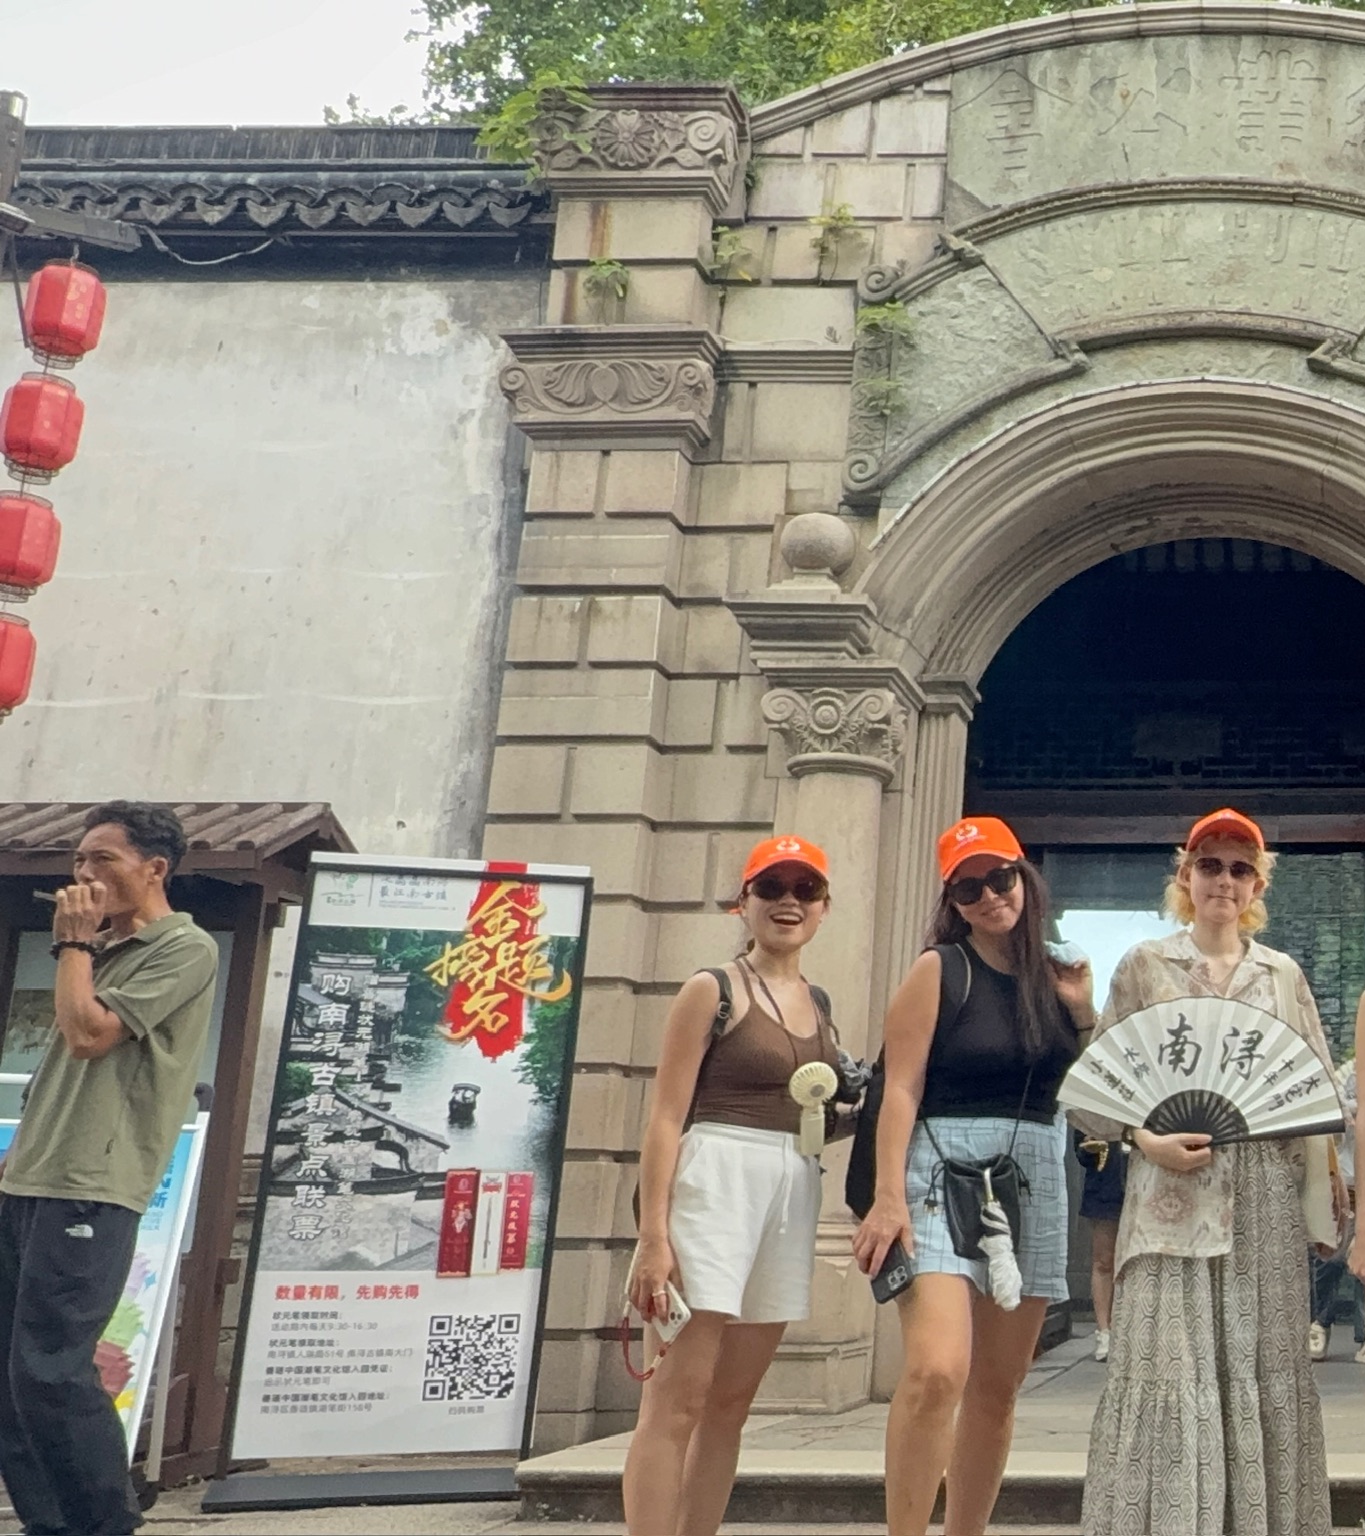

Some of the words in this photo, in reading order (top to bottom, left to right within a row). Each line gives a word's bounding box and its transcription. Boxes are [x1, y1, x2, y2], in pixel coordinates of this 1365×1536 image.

[288, 973, 352, 1241] 购南浔古镇景点联票
[1157, 1012, 1266, 1081] 南浔
